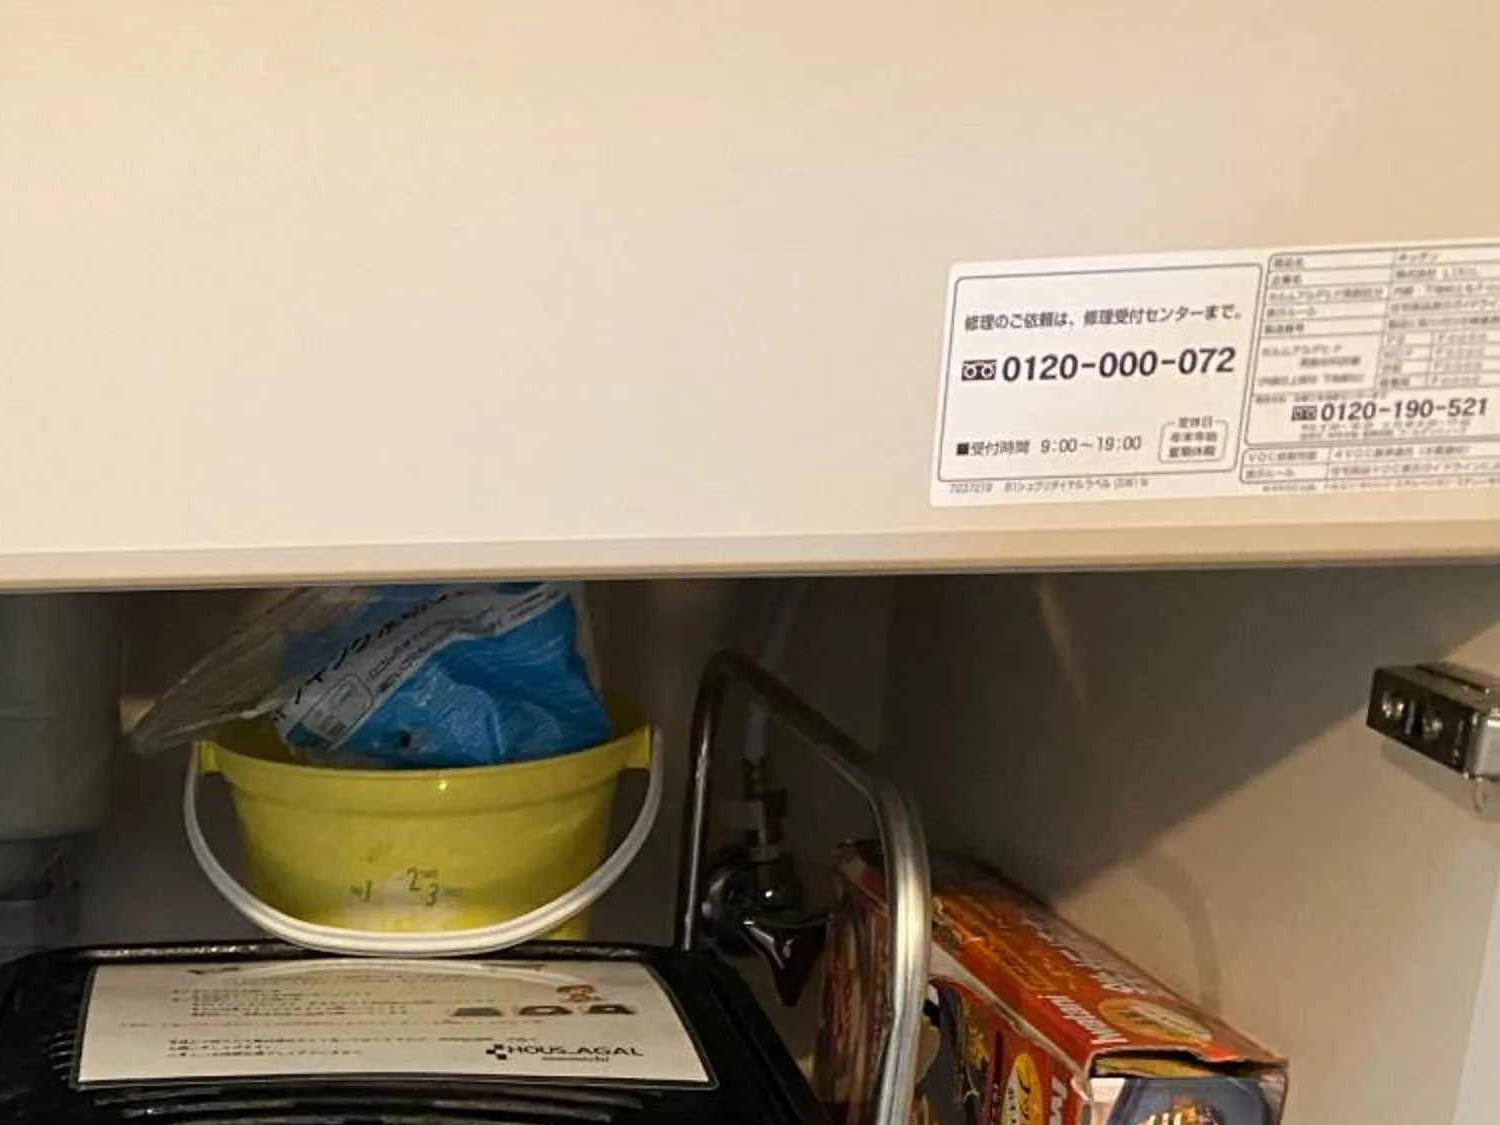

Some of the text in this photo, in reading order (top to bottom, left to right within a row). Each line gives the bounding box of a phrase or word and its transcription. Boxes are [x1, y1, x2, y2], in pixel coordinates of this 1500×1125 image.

[964, 303, 1241, 332] 修理のご依頼は、修理受付センターまで。
[1001, 347, 1237, 382] 0120-000-072
[1321, 397, 1489, 421] 0120-190-521
